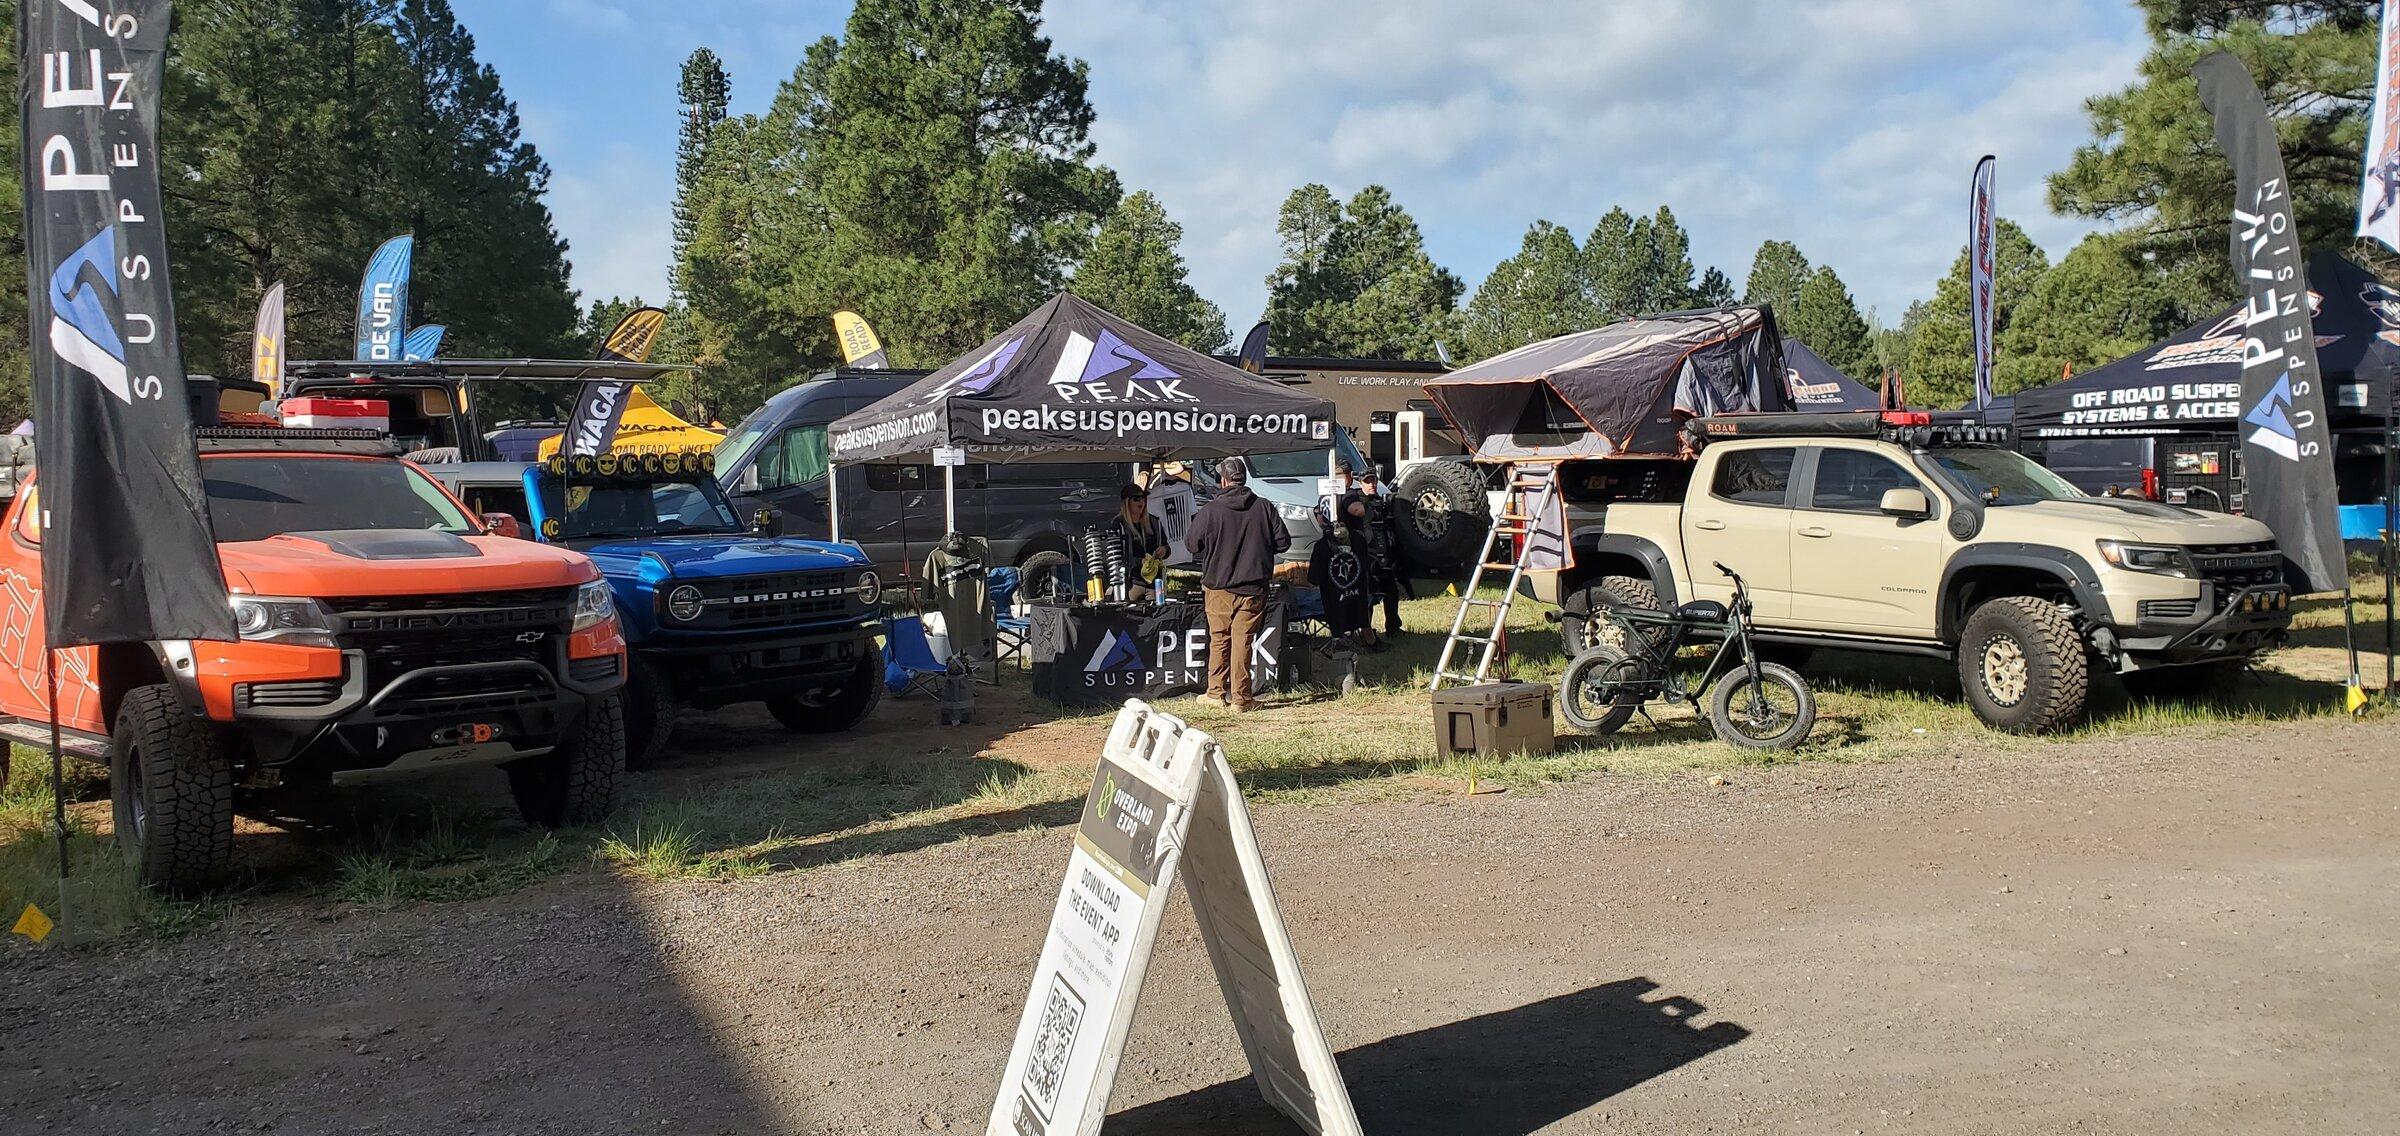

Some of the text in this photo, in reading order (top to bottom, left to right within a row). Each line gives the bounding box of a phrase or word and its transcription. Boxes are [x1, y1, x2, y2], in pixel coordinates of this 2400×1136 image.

[2264, 177, 2318, 457] SUSPENSION
[1054, 379, 1197, 402] PEAK
[2073, 383, 2240, 408] OFF ROAD SUSPE
[574, 379, 623, 457] WAGA
[982, 403, 1308, 437] peaksuspension.com
[2063, 405, 2149, 425] SYSTEMS
[2154, 404, 2170, 420] &
[834, 410, 938, 457] peaksuspension.com
[1707, 423, 1737, 432] ROAM
[551, 456, 566, 474] KC
[576, 456, 591, 474] KC
[623, 455, 637, 474] KC
[644, 456, 659, 474] KC
[684, 455, 698, 472] KC
[702, 455, 715, 472] KC
[543, 519, 559, 537] KC
[733, 587, 842, 604] BRONCO
[1881, 586, 1927, 594] COLORADO
[352, 607, 566, 631] CHEVROLET
[1157, 626, 1278, 668] PEK
[1085, 667, 1279, 687] SUSPENN
[1113, 788, 1154, 826] OVERLAND
[1116, 811, 1139, 839] EXPO
[1081, 867, 1121, 913] DOWNLOAD
[1068, 888, 1120, 947] THE EVENT APP
